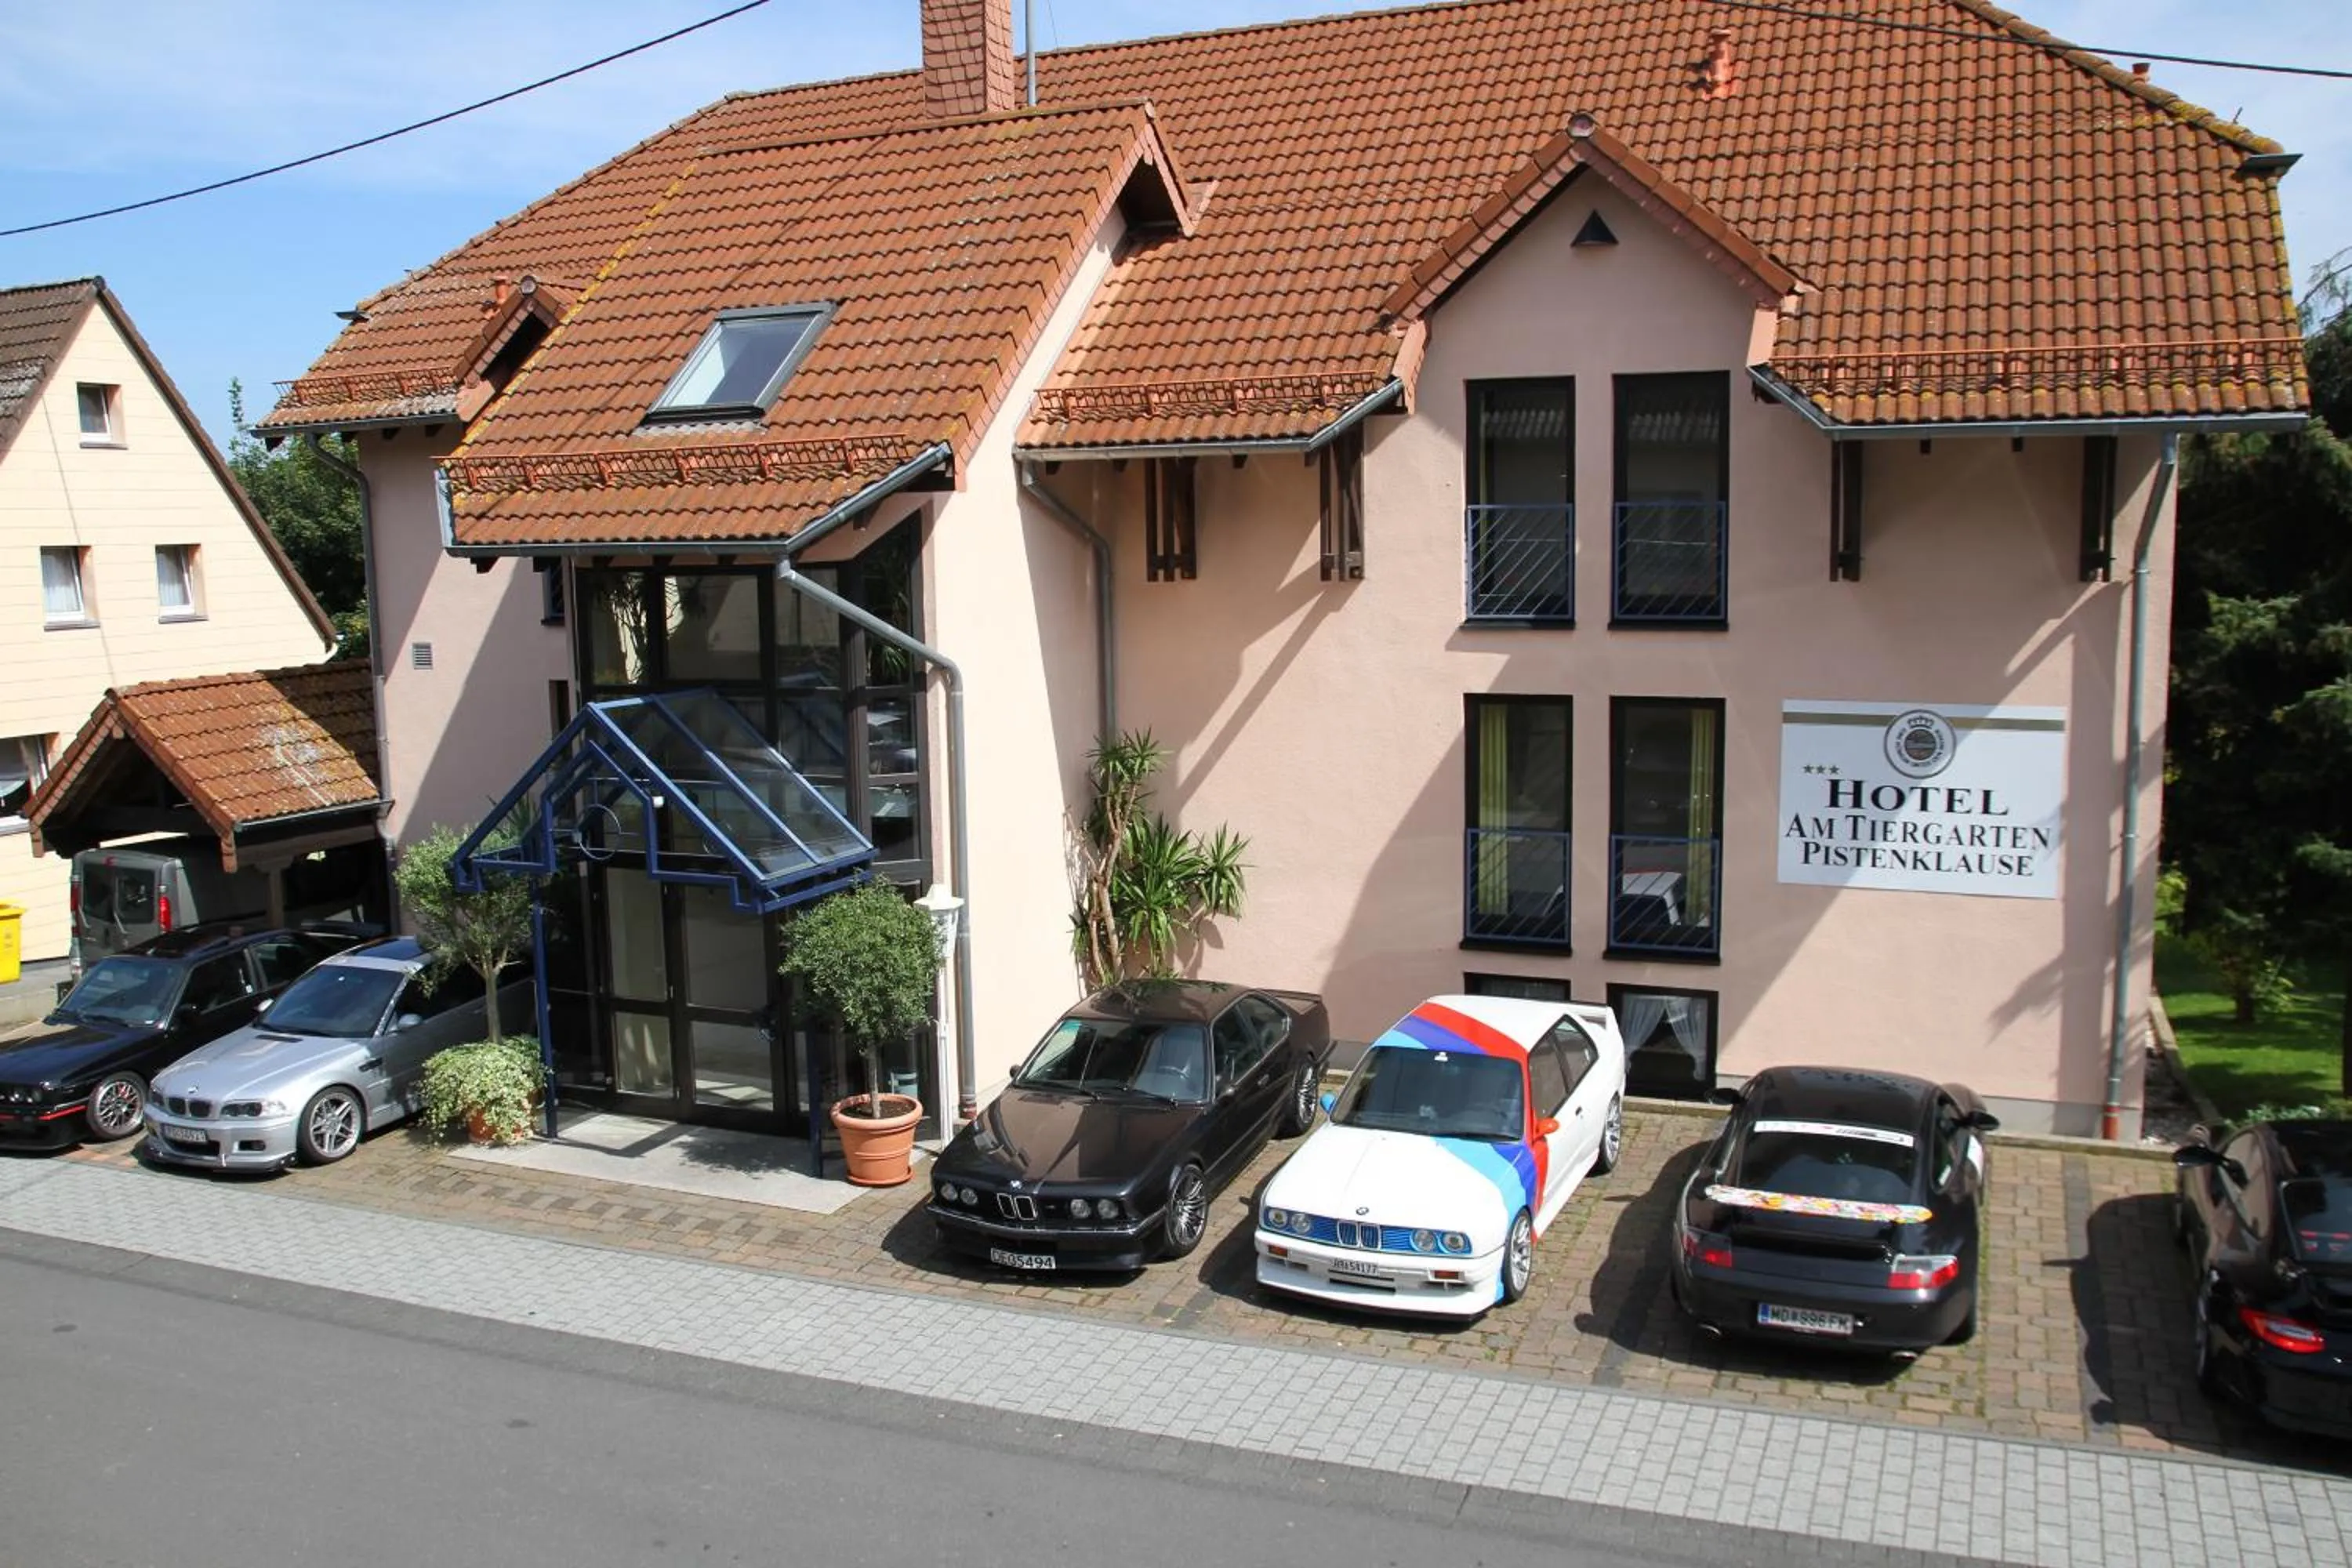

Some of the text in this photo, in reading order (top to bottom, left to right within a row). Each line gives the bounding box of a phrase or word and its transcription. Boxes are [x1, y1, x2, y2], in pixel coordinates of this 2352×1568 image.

[1825, 779, 2009, 816] HOTEL
[1785, 813, 2051, 849] AM TIERGARTEN
[1801, 841, 2034, 877] PISTENKLAUSE
